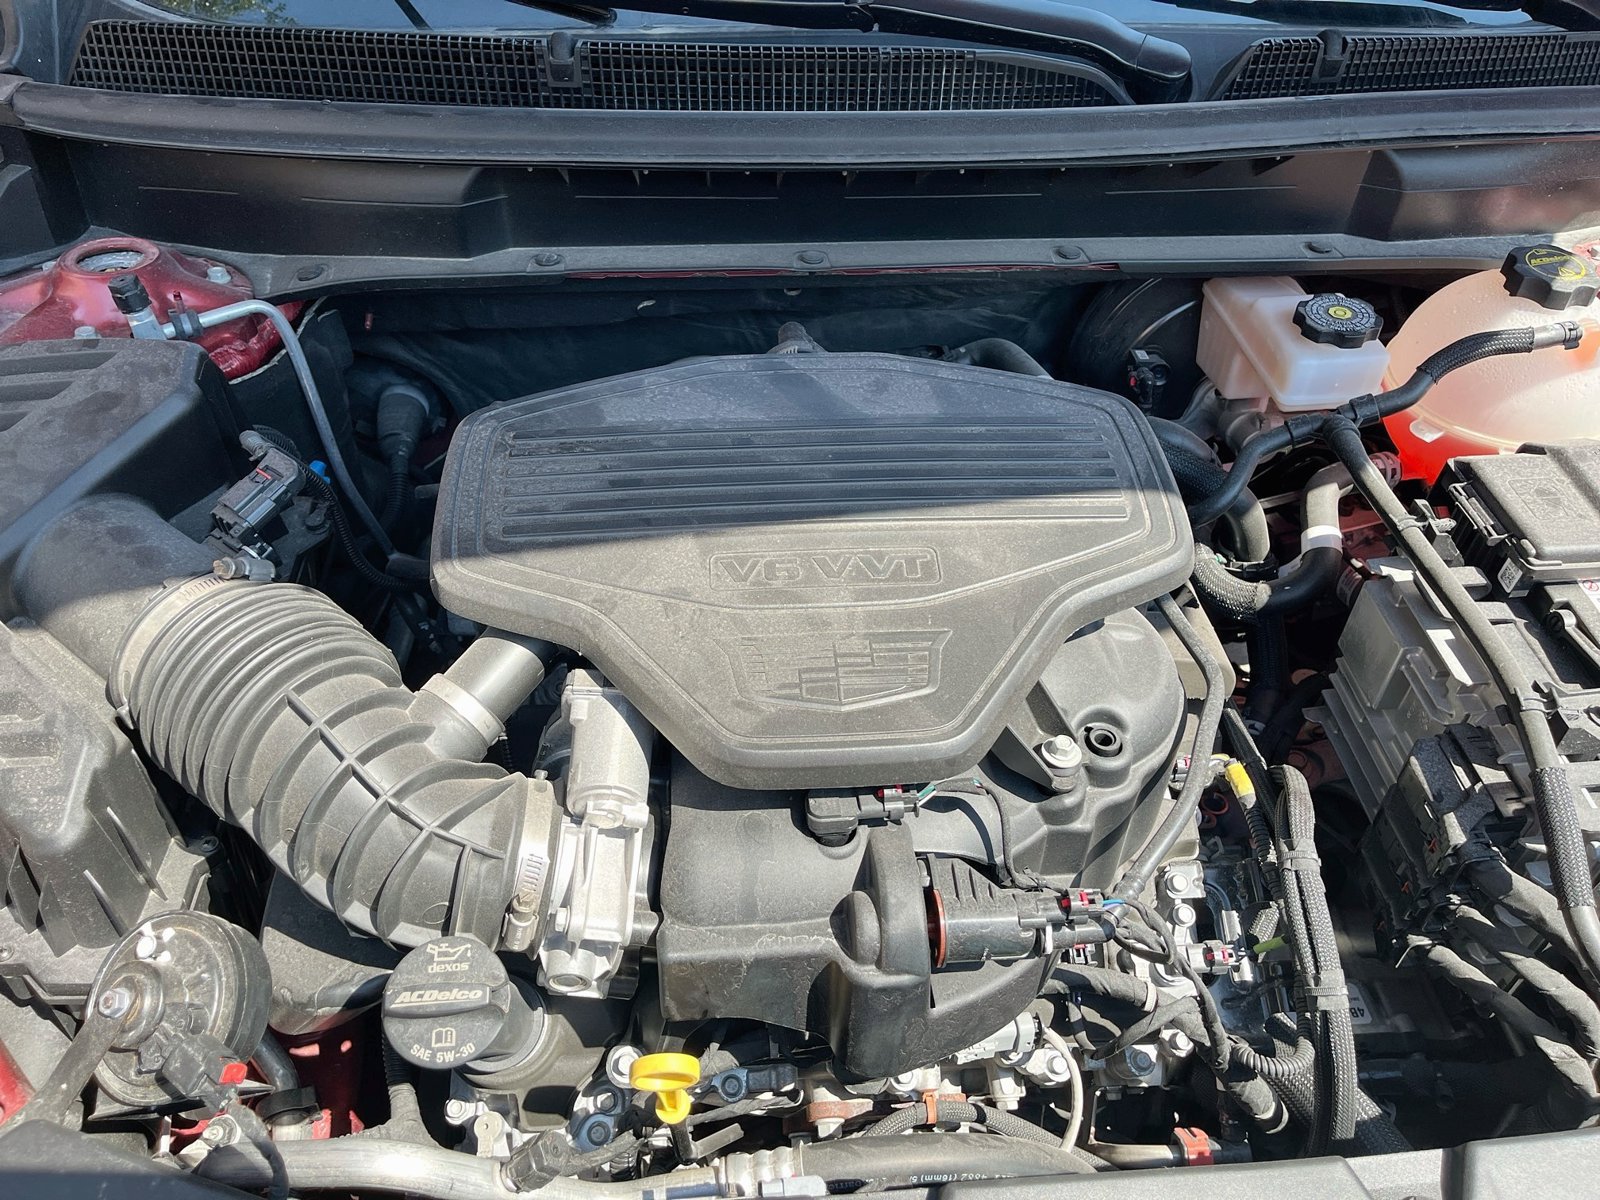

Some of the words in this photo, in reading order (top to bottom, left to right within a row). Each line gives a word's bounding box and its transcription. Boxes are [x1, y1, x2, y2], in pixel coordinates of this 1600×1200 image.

[720, 557, 801, 583] V6
[811, 554, 930, 579] VVT
[428, 962, 470, 974] dexos
[395, 988, 483, 1004] ACDelco
[410, 1044, 432, 1061] SAE
[436, 1042, 475, 1063] 5W-30
